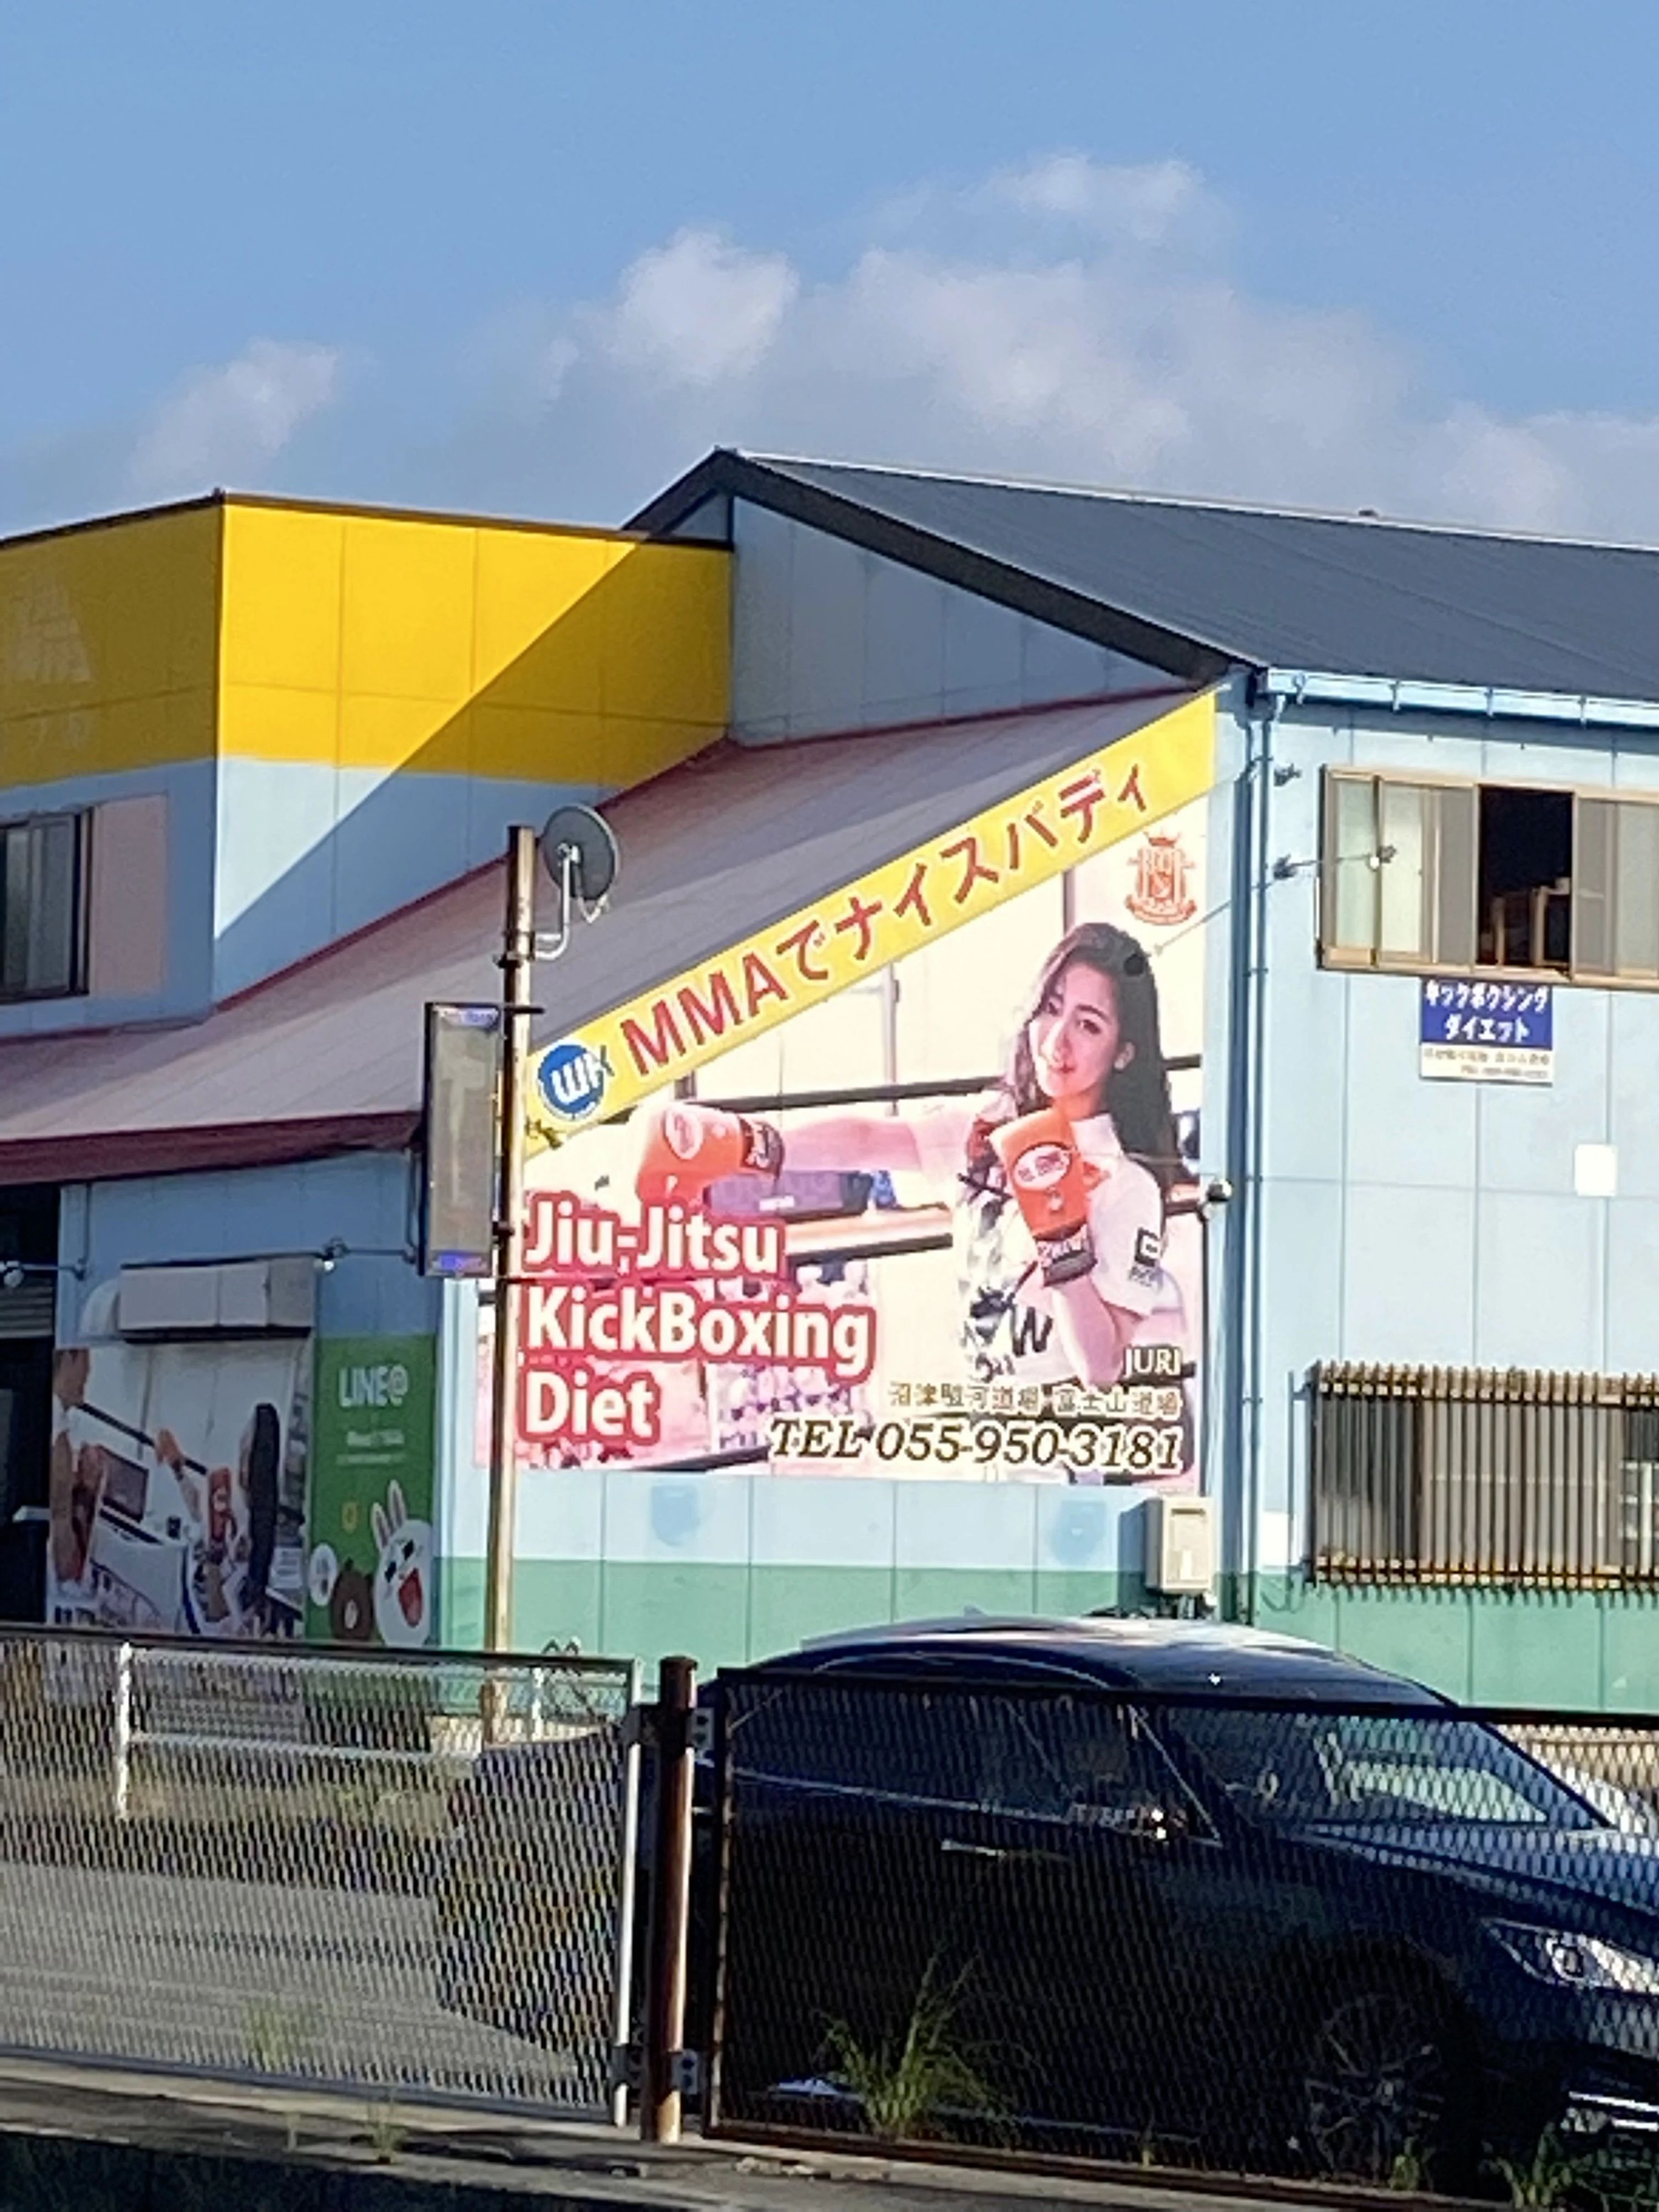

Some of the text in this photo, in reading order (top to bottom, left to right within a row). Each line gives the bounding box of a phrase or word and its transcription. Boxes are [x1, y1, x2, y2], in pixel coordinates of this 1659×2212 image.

[619, 763, 1148, 1076] MMAでナイスバディ
[1444, 1013, 1530, 1044] ダイエット
[525, 1199, 779, 1274] Jiu-Jitsu
[526, 1286, 869, 1379] KickBoxing
[1125, 1348, 1182, 1375] JURI
[338, 1364, 409, 1408] LINE@
[525, 1370, 654, 1438] Diet
[876, 1421, 1179, 1471] 055-950-3181
